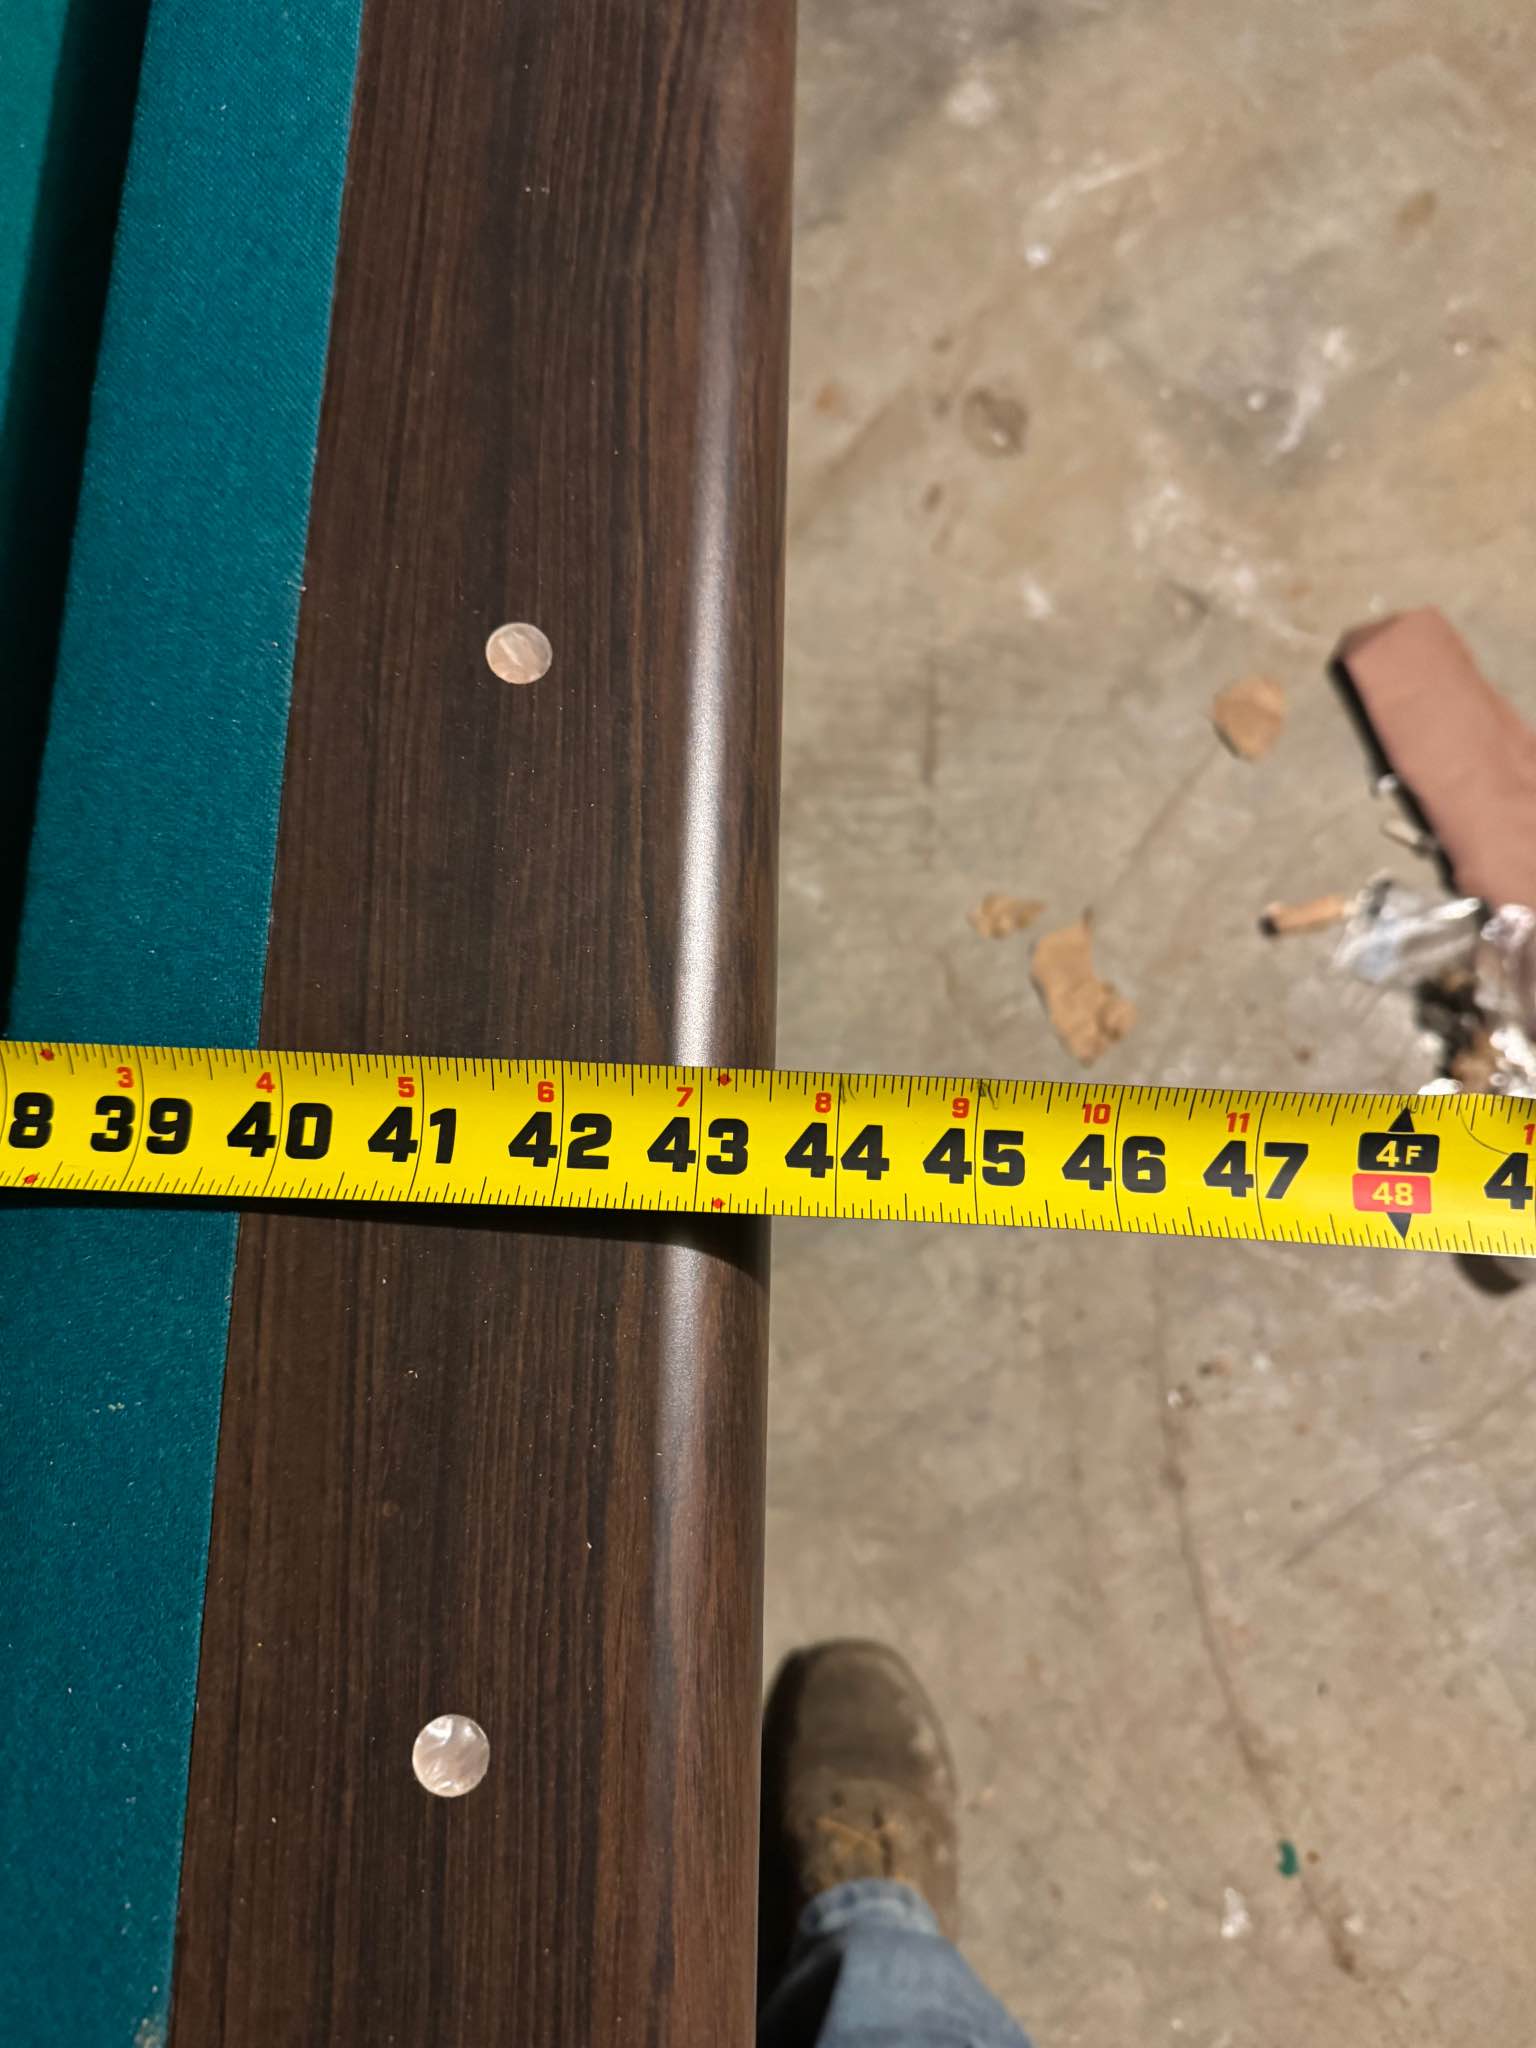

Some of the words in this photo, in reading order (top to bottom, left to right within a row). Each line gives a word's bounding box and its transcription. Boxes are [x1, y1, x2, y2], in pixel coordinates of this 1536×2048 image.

[117, 1067, 133, 1088] 3
[256, 1072, 275, 1092] 4
[398, 1077, 415, 1097] 5
[537, 1081, 555, 1102] 6
[676, 1087, 694, 1107] 7
[814, 1092, 832, 1113] 8
[952, 1098, 970, 1118] 9
[1083, 1104, 1111, 1124] 10
[1226, 1112, 1250, 1133] 11
[90, 1095, 193, 1155] 39
[226, 1101, 333, 1160] 40
[367, 1106, 457, 1164] 41
[508, 1111, 612, 1170] 42
[646, 1116, 749, 1175] 43
[784, 1122, 890, 1181] 44
[922, 1127, 1025, 1187] 45
[1061, 1133, 1166, 1194] 46
[1203, 1140, 1309, 1199] 47
[1371, 1183, 1414, 1206] 48
